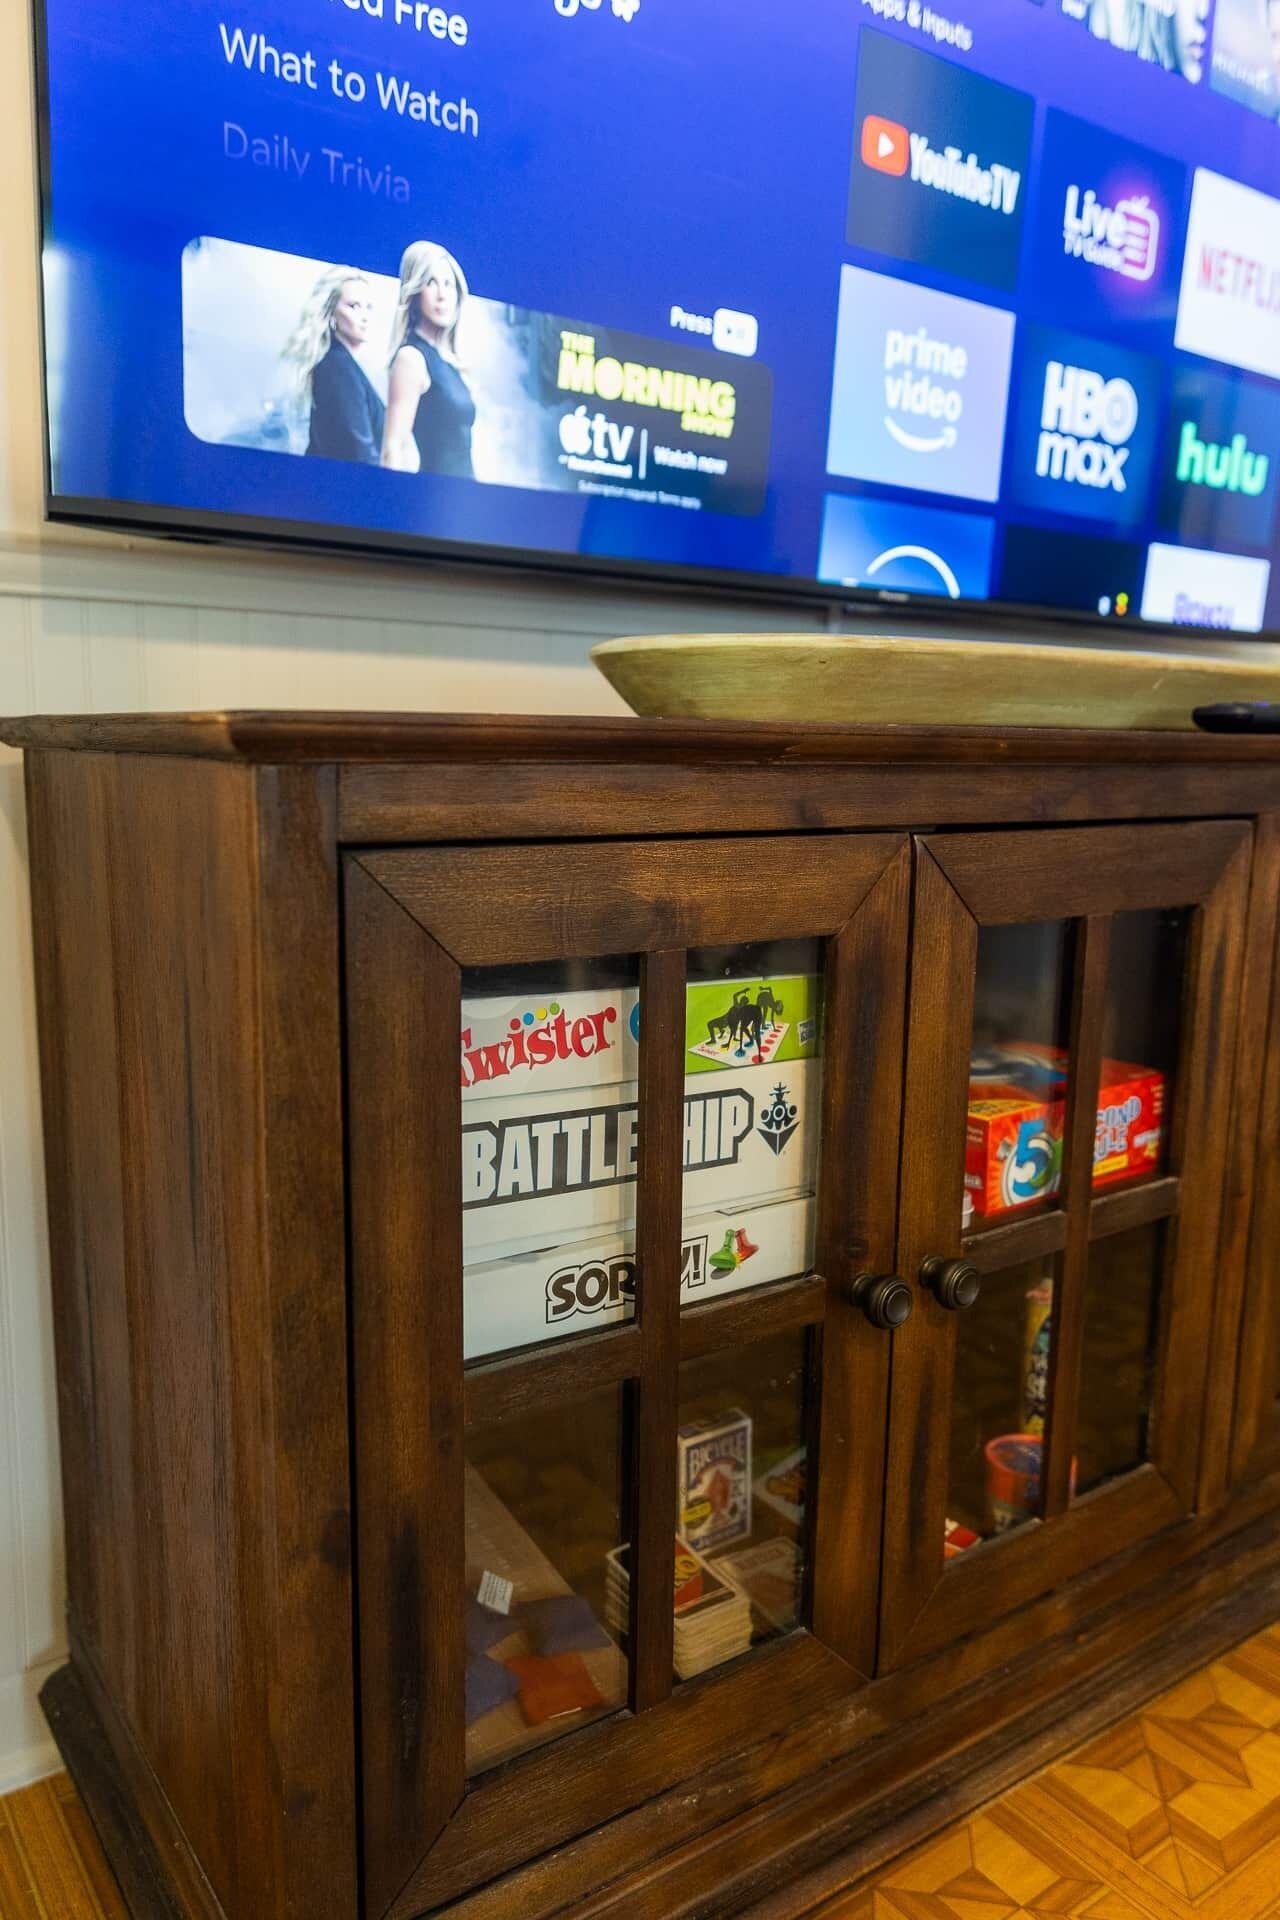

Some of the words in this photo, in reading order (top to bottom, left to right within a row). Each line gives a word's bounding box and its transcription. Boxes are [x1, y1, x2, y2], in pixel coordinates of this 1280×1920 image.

[395, 0, 468, 46] Free
[922, 7, 972, 51] Inputs
[219, 23, 317, 89] What
[328, 59, 365, 102] to
[376, 72, 480, 137] Watch
[223, 121, 311, 177] Daily
[321, 148, 411, 202] Trivia
[1064, 185, 1127, 247] Live
[557, 349, 736, 419] MORNING
[885, 327, 968, 379] prime
[885, 372, 963, 422] video
[1041, 361, 1138, 445] HBO
[591, 413, 634, 462] tv
[1036, 430, 1129, 492] max
[1176, 421, 1269, 496] hulu
[462, 1087, 753, 1209] BATTLEHIP
